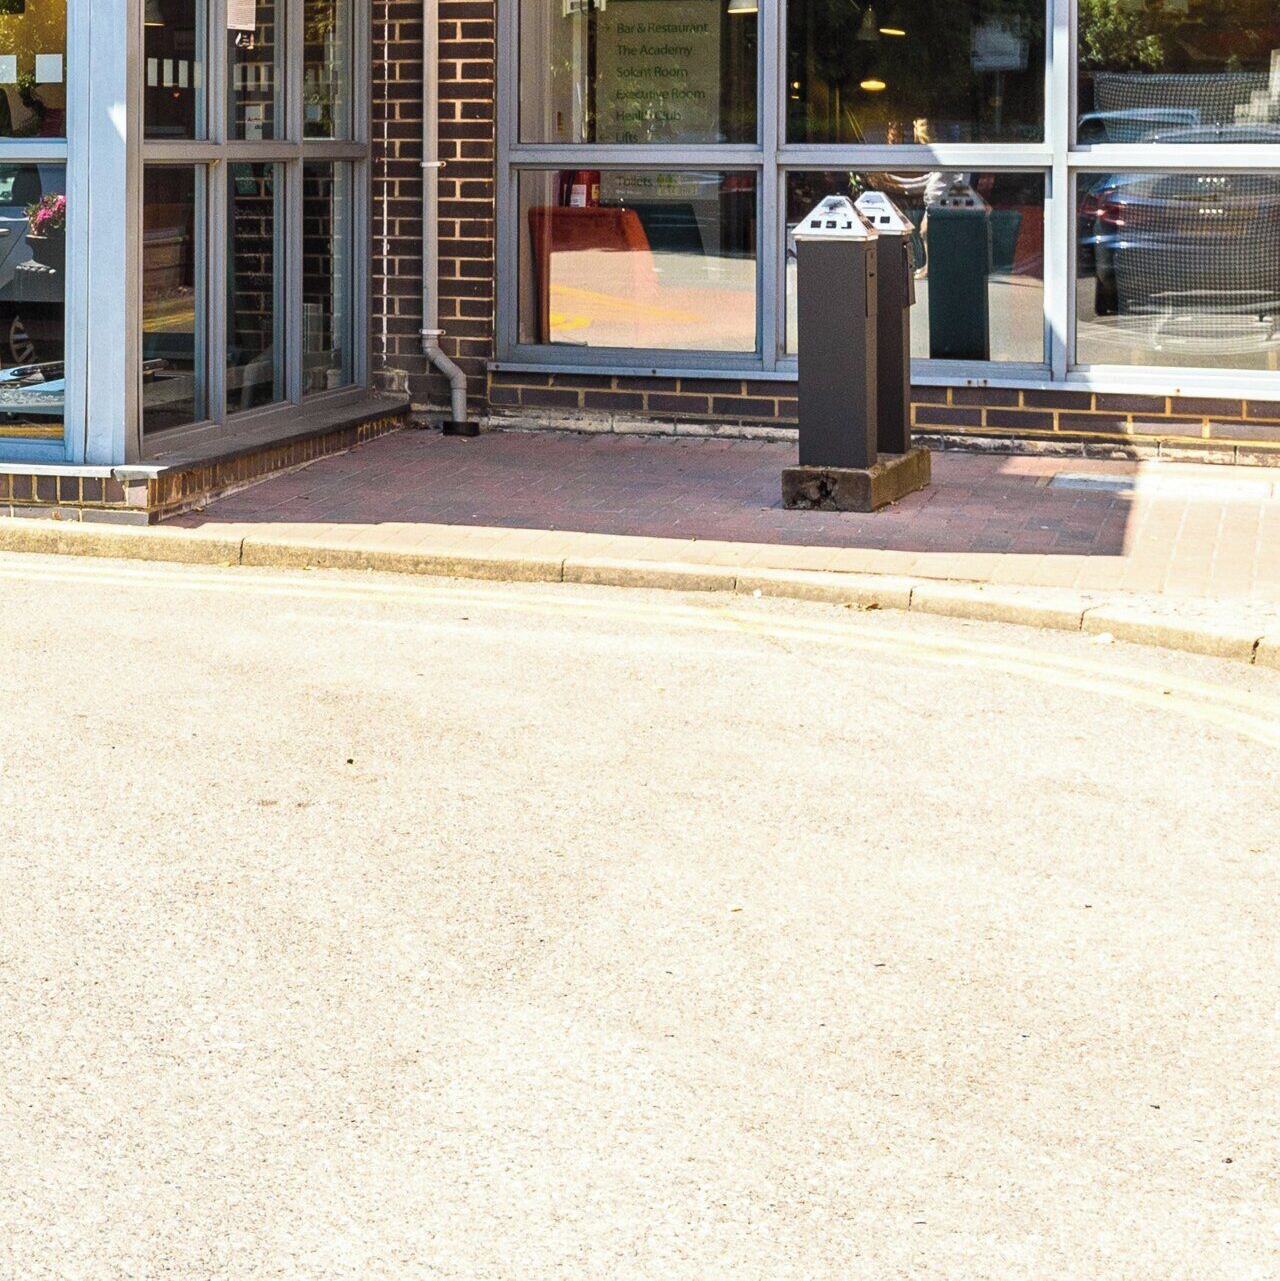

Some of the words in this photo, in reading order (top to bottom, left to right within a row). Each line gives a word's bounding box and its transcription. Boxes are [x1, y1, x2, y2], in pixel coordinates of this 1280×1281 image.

[616, 23, 635, 34] Bar
[636, 24, 646, 34] &
[648, 22, 709, 33] Restaurant
[617, 45, 638, 56] The
[639, 44, 694, 58] Academy
[616, 67, 652, 78] Solent
[654, 66, 689, 78] Room
[616, 89, 670, 100] Executive
[671, 88, 706, 99] Room
[615, 131, 639, 143] Lifts
[615, 176, 653, 186] Toilets
